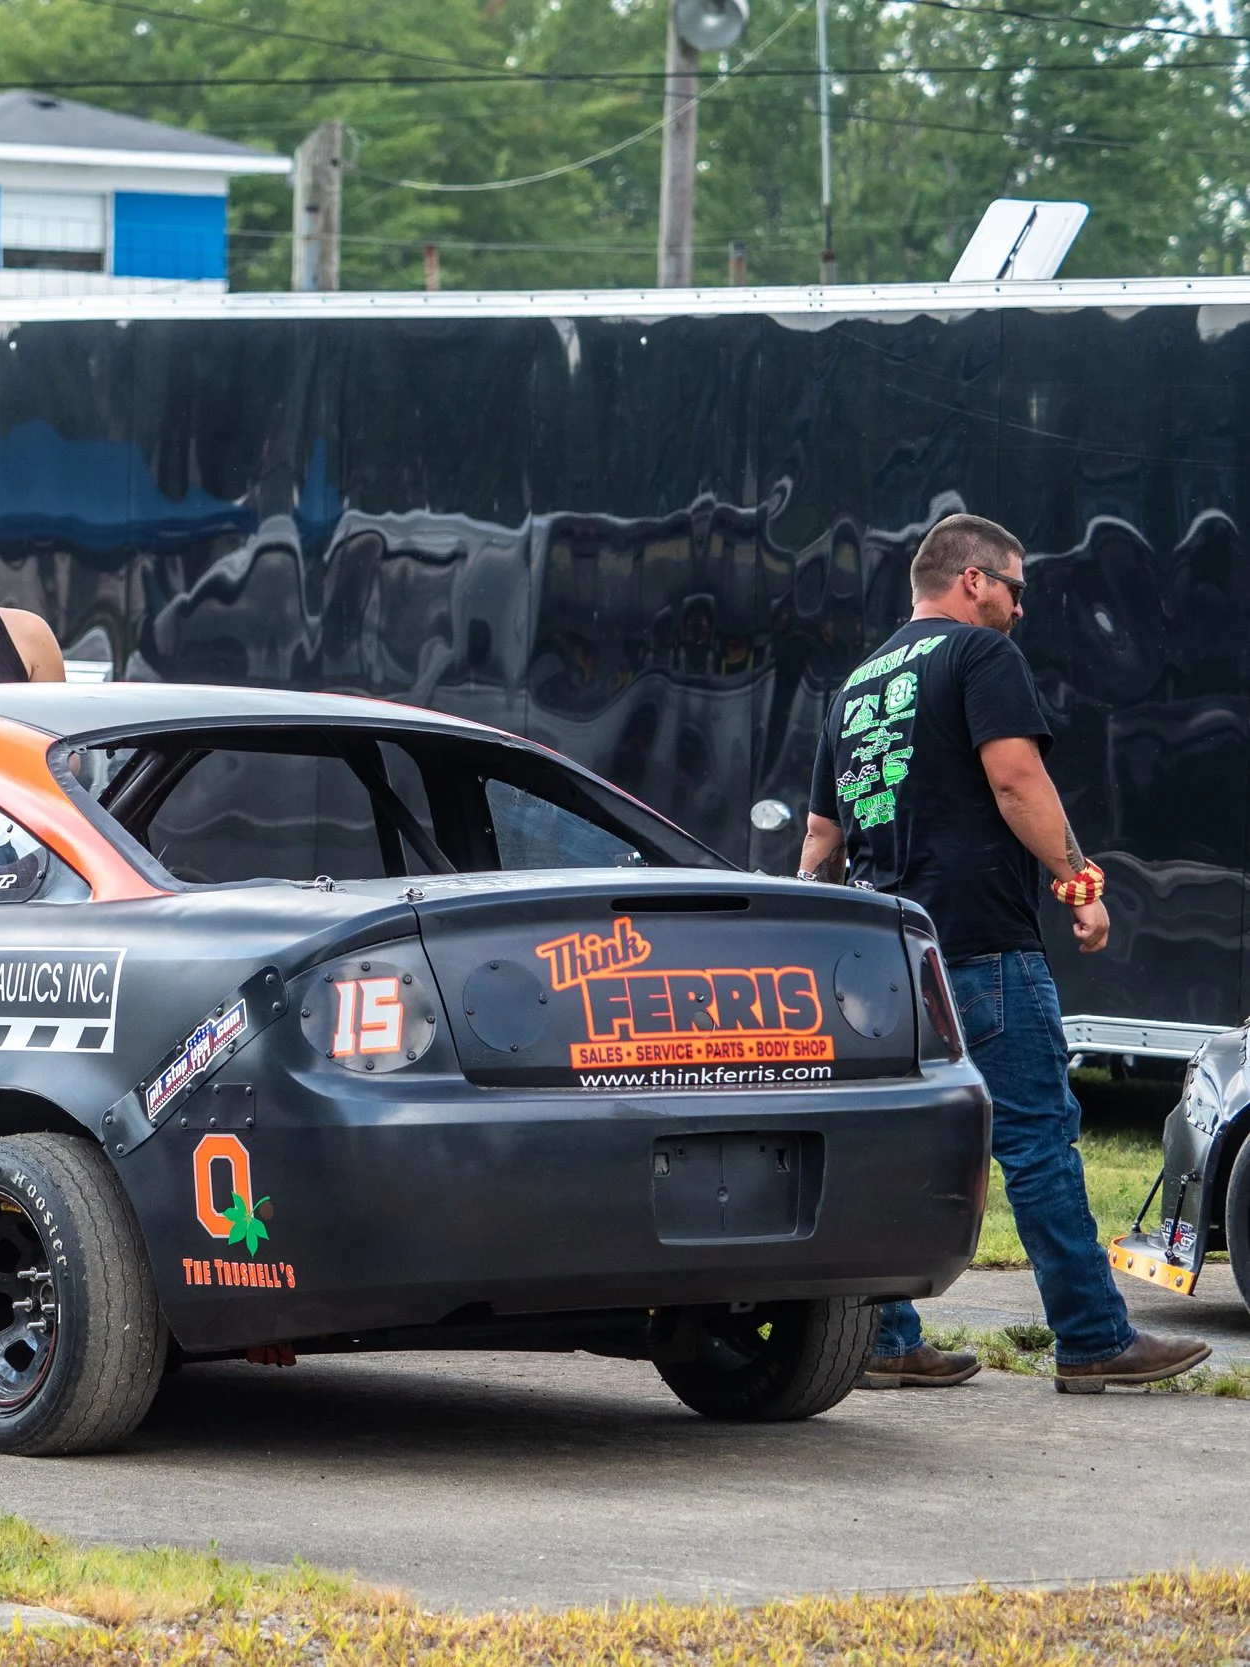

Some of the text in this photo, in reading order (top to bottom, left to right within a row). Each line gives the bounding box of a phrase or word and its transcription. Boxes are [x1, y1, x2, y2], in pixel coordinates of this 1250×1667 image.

[535, 916, 651, 991] Think
[67, 962, 110, 1003] INC.
[582, 966, 823, 1041] FERRIS
[333, 977, 403, 1058] 15
[580, 1040, 827, 1064] SALES SERVICE PARTS BODY SHOP
[149, 1080, 162, 1108] pit
[165, 1058, 188, 1088] stop
[579, 1064, 831, 1087] www.thinkferris.com
[183, 1258, 211, 1285] THE
